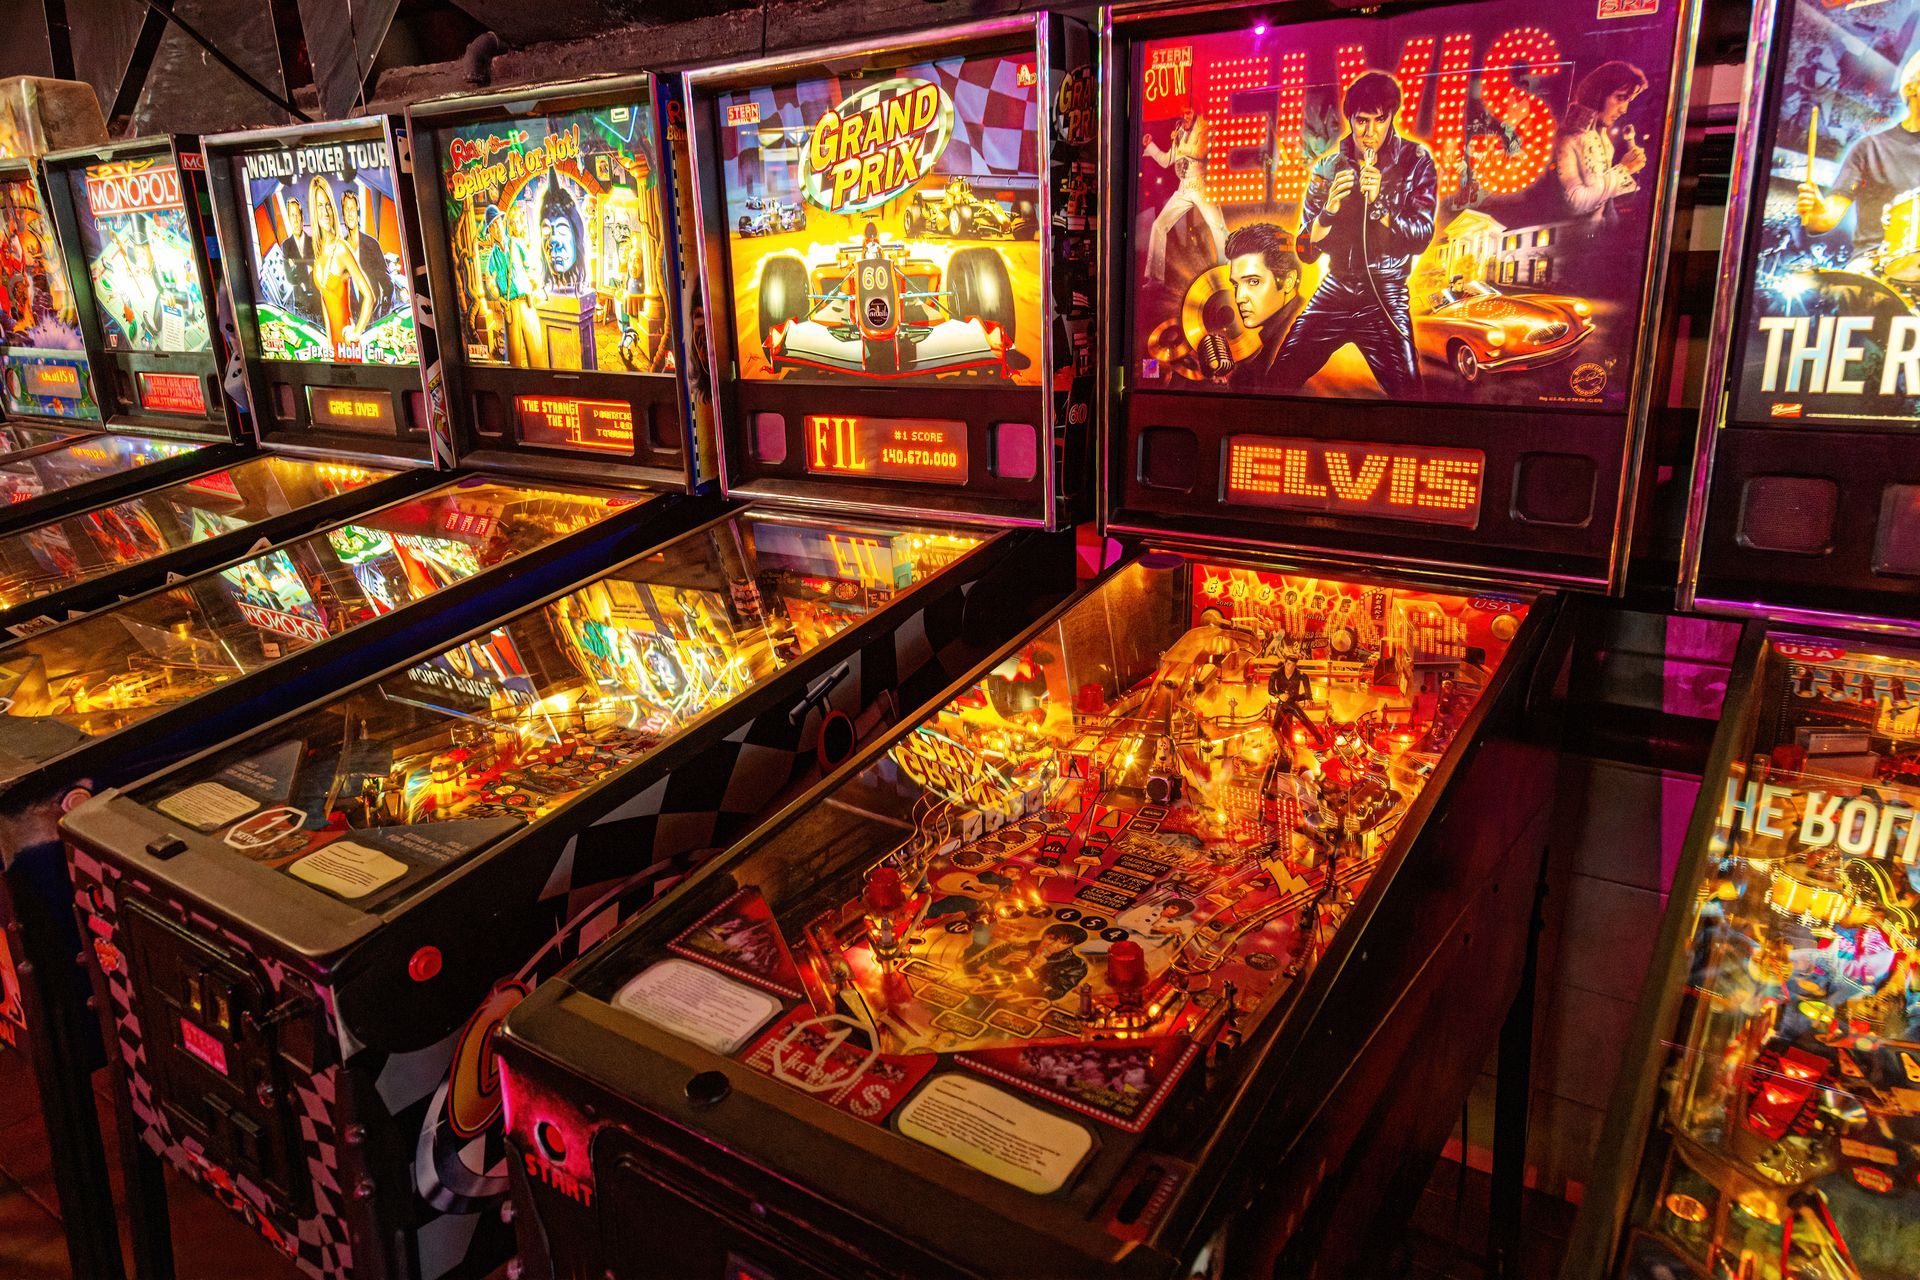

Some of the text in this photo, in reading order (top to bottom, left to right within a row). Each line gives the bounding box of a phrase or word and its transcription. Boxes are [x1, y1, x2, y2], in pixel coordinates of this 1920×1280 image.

[1152, 47, 1191, 64] STERN
[728, 104, 759, 120] STERN
[810, 82, 941, 174] GRAND
[244, 142, 390, 179] WORLD POKER TOUR
[453, 123, 580, 201] Believe It or Not!
[830, 134, 922, 213] PRIX
[89, 172, 179, 211] MONOPOLY
[862, 265, 888, 290] 60
[306, 341, 335, 359] Texas
[337, 342, 362, 359] Hold
[1759, 316, 1875, 395] THE
[329, 400, 379, 418] GAME OVER
[522, 400, 539, 413] THE
[1069, 404, 1087, 424] 60
[546, 415, 564, 427] THE
[812, 417, 866, 470] FIL
[894, 430, 943, 443] #1 SCORE
[1228, 443, 1481, 511] ELVIS
[1474, 600, 1511, 612] USA
[1780, 645, 1835, 659] USA
[1044, 845, 1061, 853] ALL
[1090, 888, 1109, 896] TOP
[1061, 909, 1076, 919] 6
[1086, 917, 1101, 928] 5
[1108, 930, 1121, 940] 4
[524, 1152, 593, 1207] START
